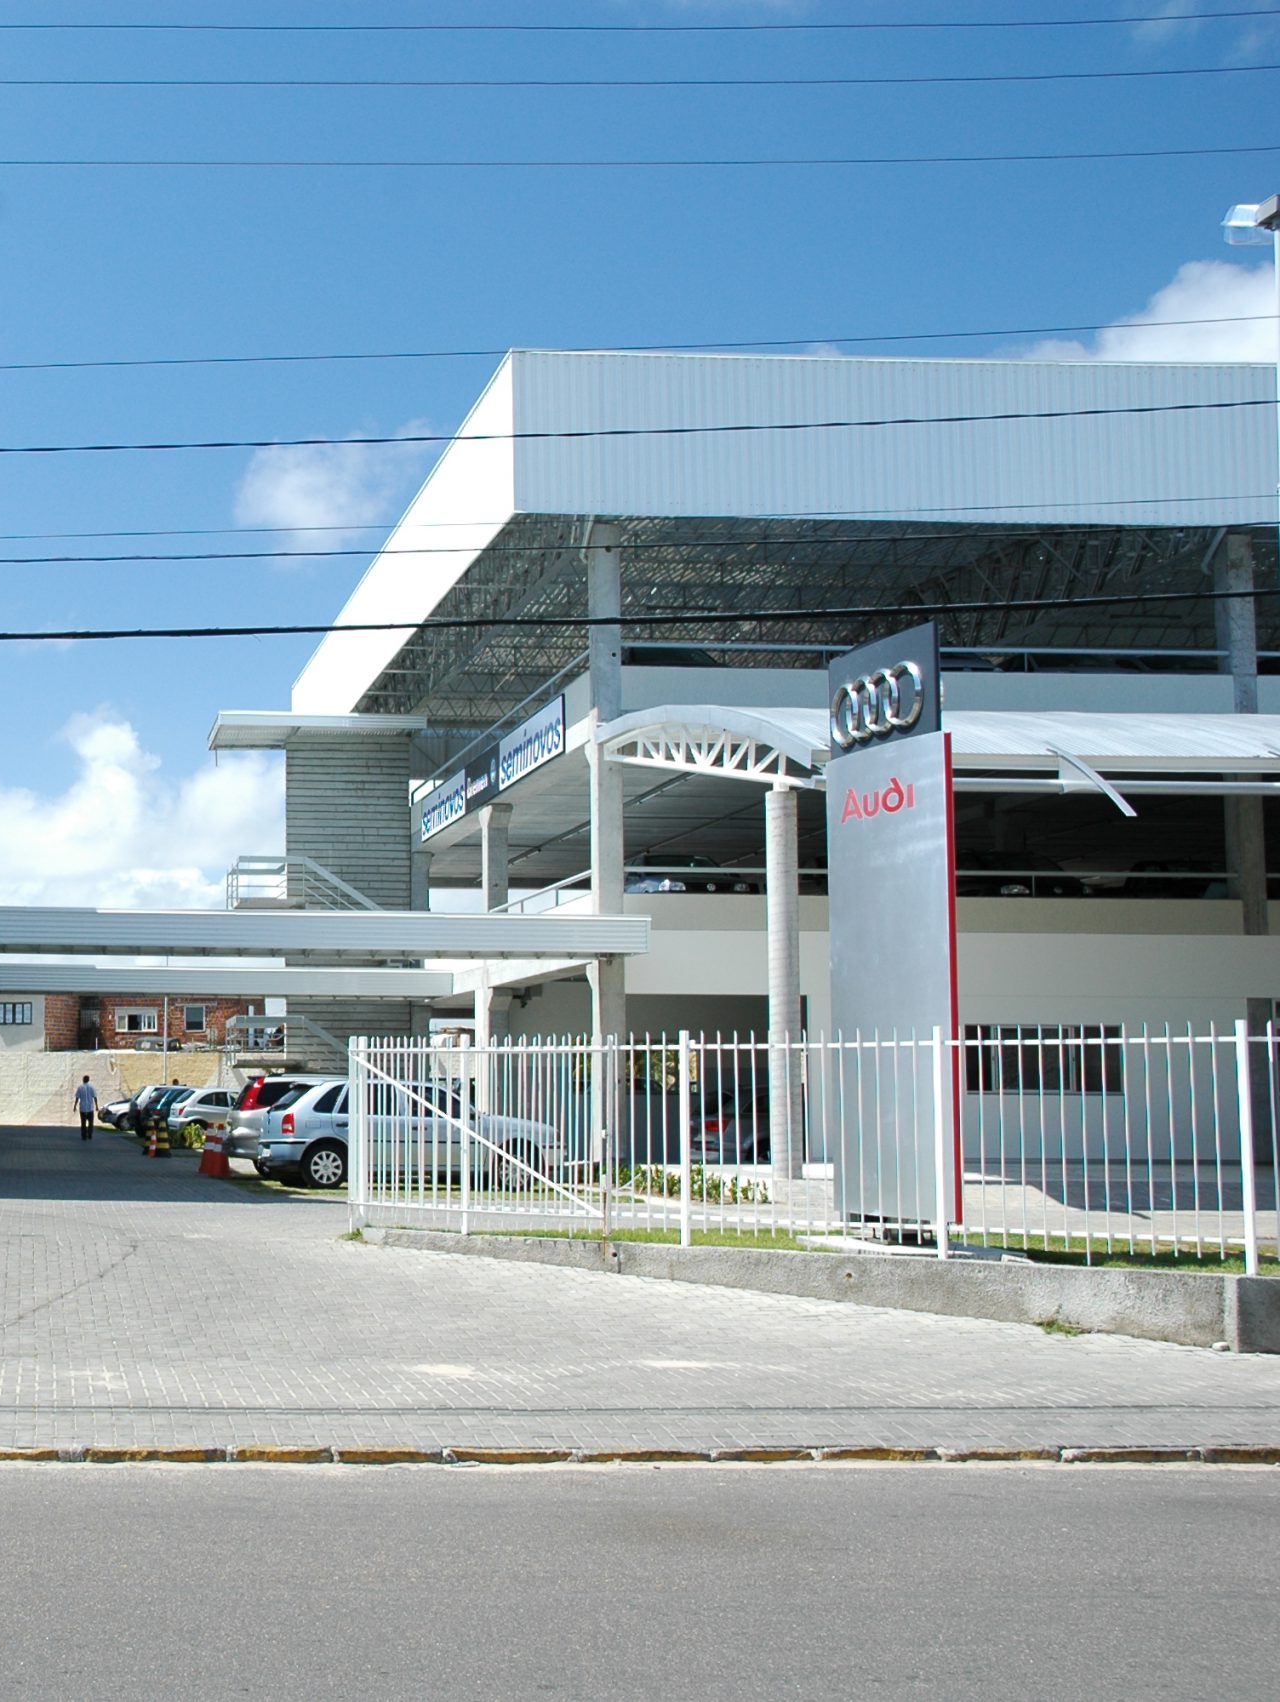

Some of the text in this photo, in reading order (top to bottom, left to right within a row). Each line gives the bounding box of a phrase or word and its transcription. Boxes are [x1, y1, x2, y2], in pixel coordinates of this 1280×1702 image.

[501, 717, 561, 785] seminovos
[422, 784, 464, 836] seminovos
[841, 777, 916, 824] Audi
